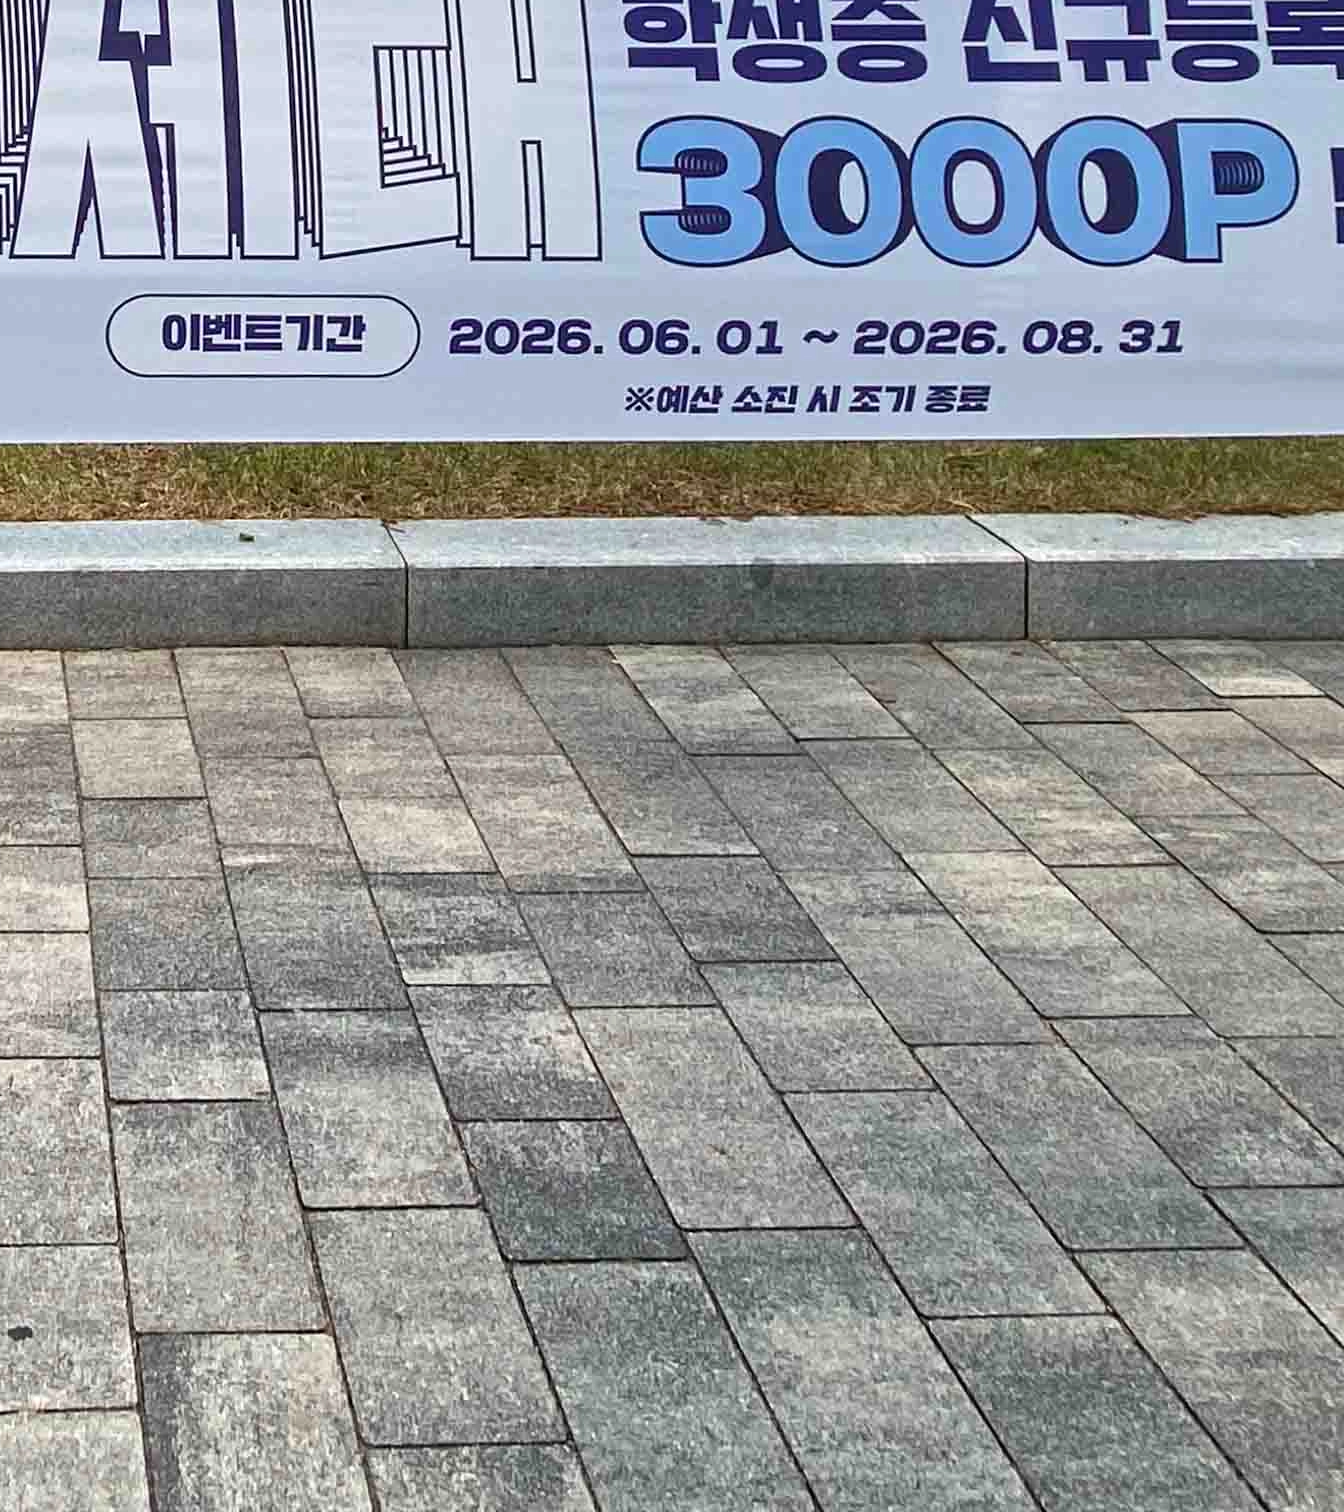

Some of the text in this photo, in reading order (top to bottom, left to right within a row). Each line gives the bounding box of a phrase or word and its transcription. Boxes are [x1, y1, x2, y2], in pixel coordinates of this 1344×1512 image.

[636, 115, 1300, 268] 3000P
[162, 314, 366, 353] 이벤트기간
[449, 318, 604, 355] 2026.
[619, 319, 701, 355] 06.
[716, 319, 783, 355] 01
[854, 320, 1007, 355] 2026.
[1022, 320, 1102, 355] 08.
[1119, 319, 1183, 354] 31
[731, 385, 798, 414] 소진
[806, 385, 841, 413] 시
[849, 385, 916, 413] 조기
[925, 385, 991, 414] 종료
